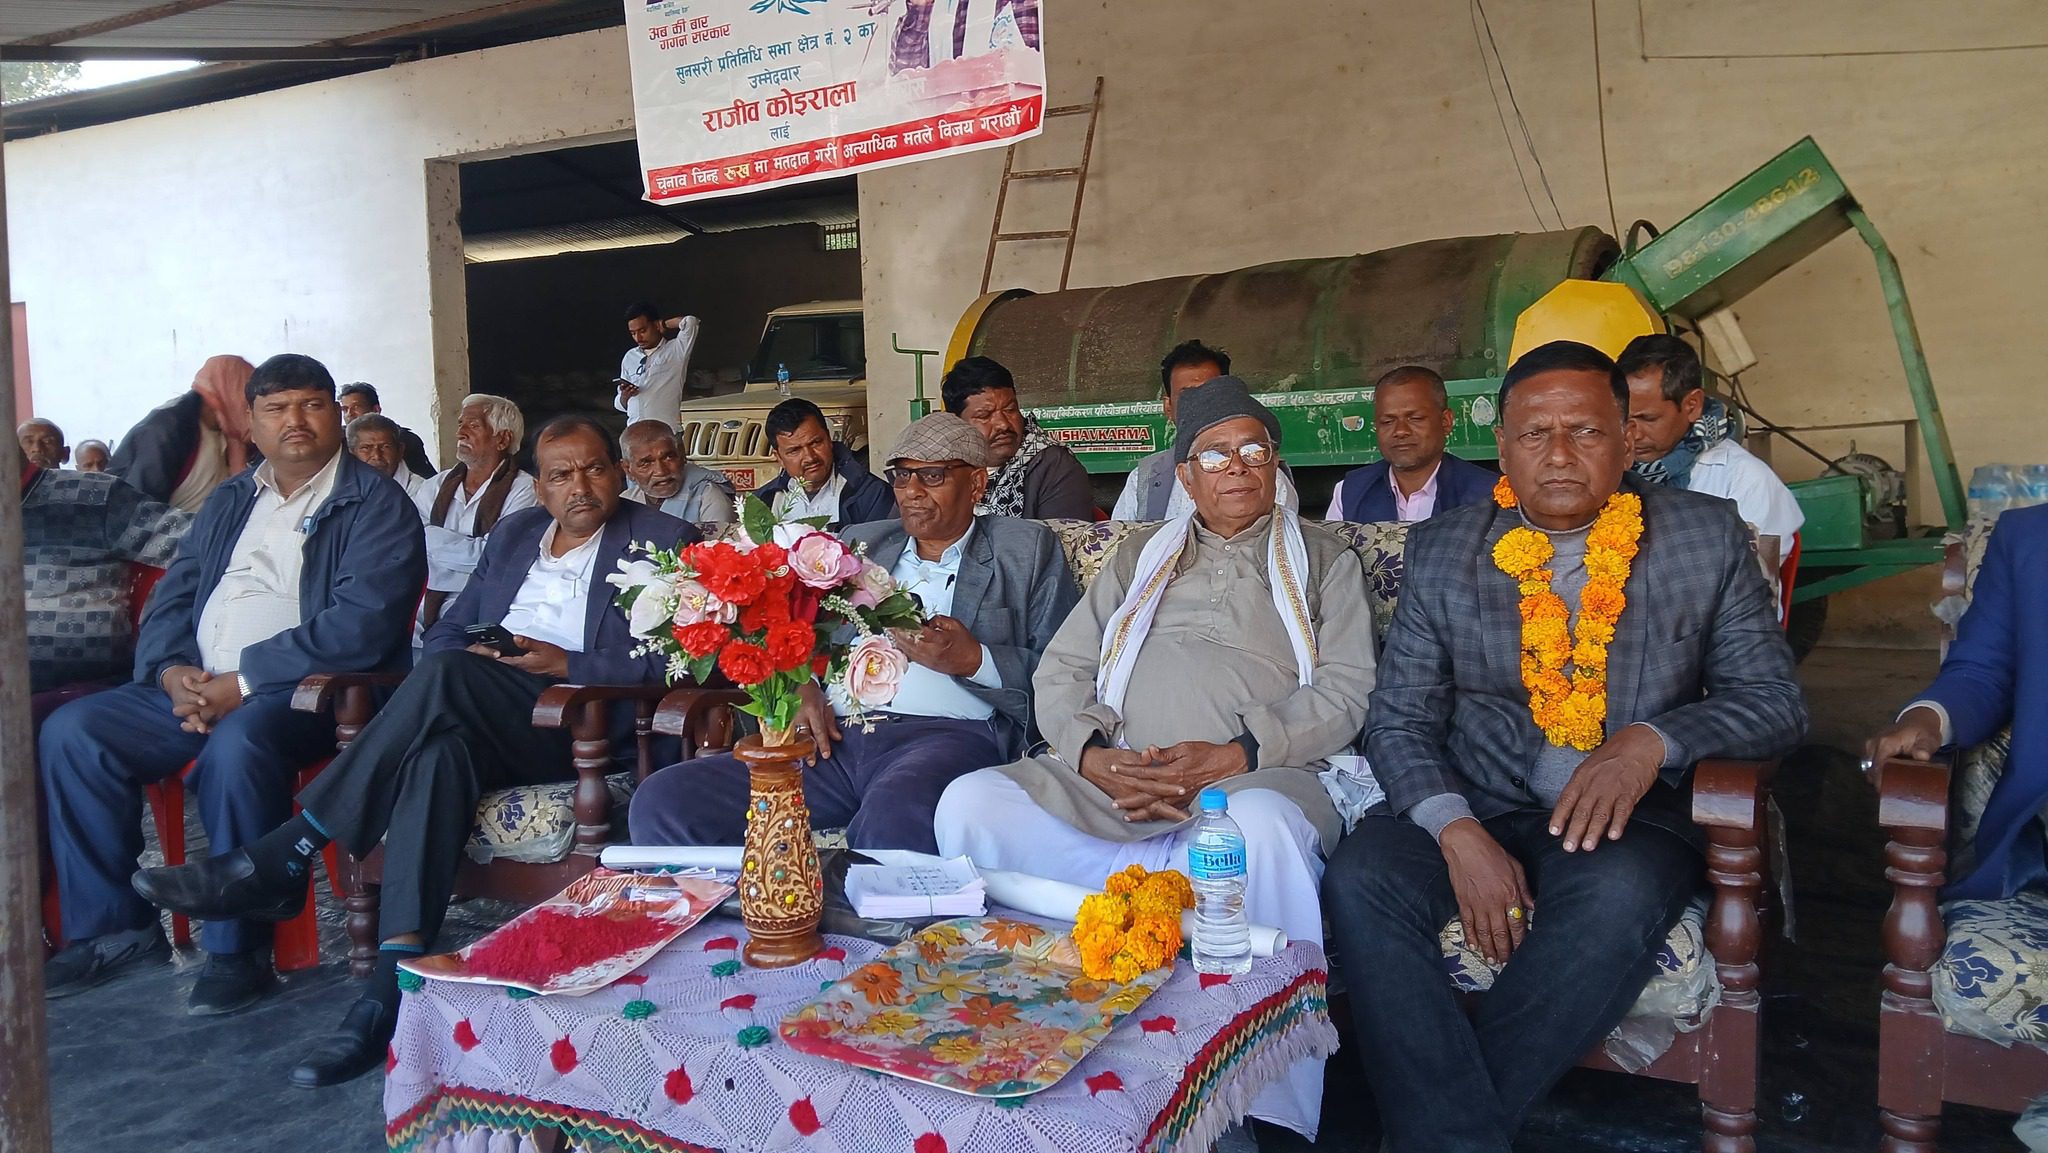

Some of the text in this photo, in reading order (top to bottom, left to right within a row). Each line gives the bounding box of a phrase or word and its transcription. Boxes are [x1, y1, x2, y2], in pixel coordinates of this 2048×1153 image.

[649, 16, 709, 40] अब की बार
[659, 24, 731, 50] गगन सरकार
[676, 56, 712, 84] सुनसरी
[717, 45, 762, 72] प्रतिनिधि
[768, 42, 792, 59] सभा
[798, 34, 819, 53] क्षेत्र
[843, 28, 851, 45] २
[858, 22, 876, 38] का
[748, 66, 801, 88] उम्मेदवार
[702, 98, 760, 132] राजीव
[766, 81, 856, 117] कोइराला
[769, 121, 790, 141] लाई
[655, 173, 687, 194] चुनाव
[692, 168, 719, 187] चिन्ह
[754, 159, 768, 174] मा
[773, 151, 810, 170] मतदान
[815, 143, 837, 163] गरी
[843, 134, 898, 159] अत्याधिक
[903, 124, 933, 145] मतले
[938, 119, 974, 139] विजय
[1049, 428, 1149, 441] VISHAVKARMA
[1203, 853, 1241, 867] Bella
